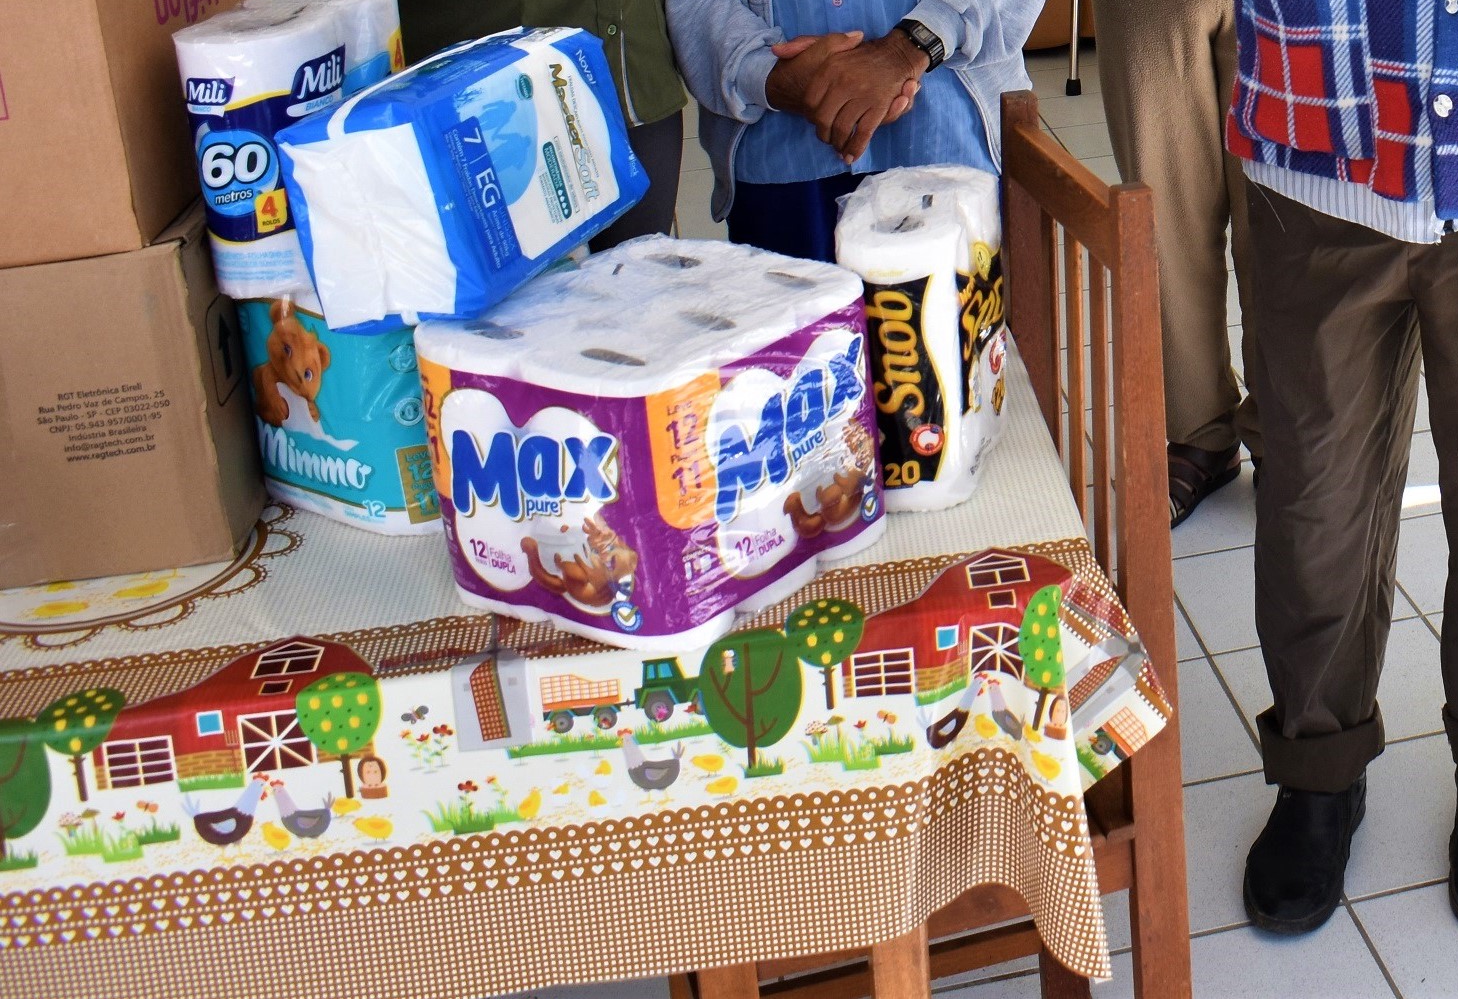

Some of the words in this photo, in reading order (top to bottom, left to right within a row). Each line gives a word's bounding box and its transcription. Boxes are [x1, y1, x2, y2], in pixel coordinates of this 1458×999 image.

[297, 53, 342, 100] Mili
[188, 80, 227, 104] Mili
[202, 143, 270, 189] 60
[463, 127, 482, 144] 7
[476, 167, 501, 208] EG
[215, 189, 253, 205] metros
[261, 195, 279, 218] 4
[262, 219, 281, 227] ROLOS
[866, 290, 924, 417] Snob
[38, 406, 55, 414] Rua
[57, 403, 81, 412] Pedro
[83, 400, 99, 408] Vaz
[101, 398, 112, 406] de
[114, 393, 152, 405] Campos,
[154, 389, 165, 398] 25
[57, 392, 74, 401] RGT
[77, 388, 120, 399] Eletrônica
[121, 382, 142, 393] Eireli
[37, 416, 53, 425] São
[55, 414, 79, 422] Paulo
[86, 410, 97, 419] SP
[105, 407, 121, 416] CEP
[716, 333, 865, 522] Max
[108, 425, 147, 437] Brasileira
[64, 433, 155, 453] info@ragtech.com.br
[66, 443, 156, 462] www.ragtech.com.br
[256, 415, 372, 489] Mimmo
[792, 430, 824, 467] pure
[451, 428, 615, 513] Max
[885, 460, 921, 486] 20
[362, 500, 387, 518] 12
[526, 498, 559, 516] pure
[470, 539, 487, 559] 12
[735, 536, 754, 560] 12
[755, 527, 777, 544] Folha
[758, 535, 785, 555] DUPLA
[491, 558, 517, 575] DUPLA
